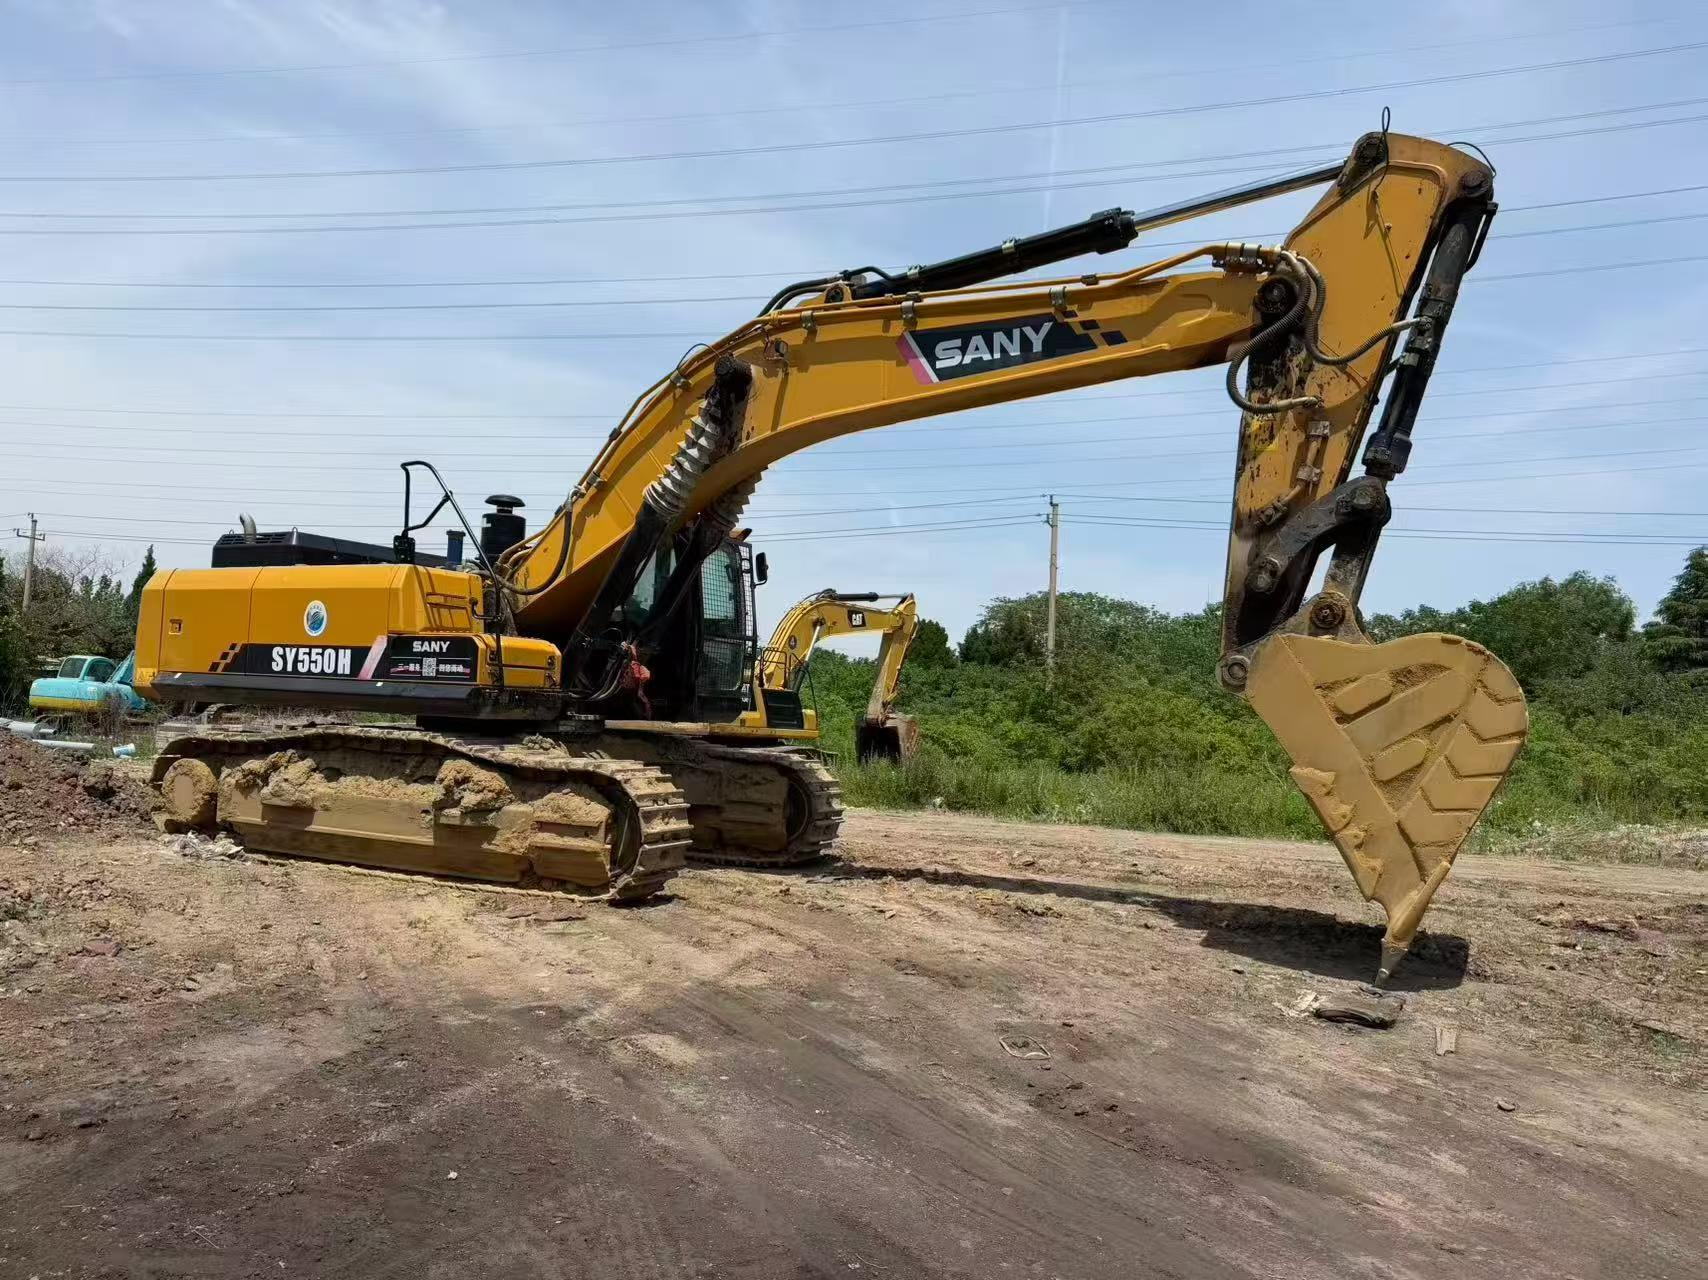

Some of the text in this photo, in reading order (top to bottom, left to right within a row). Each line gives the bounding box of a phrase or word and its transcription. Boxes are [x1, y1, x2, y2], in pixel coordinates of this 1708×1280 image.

[935, 322, 1053, 369] SANY
[271, 646, 351, 675] SY550H
[413, 640, 450, 652] SANY
